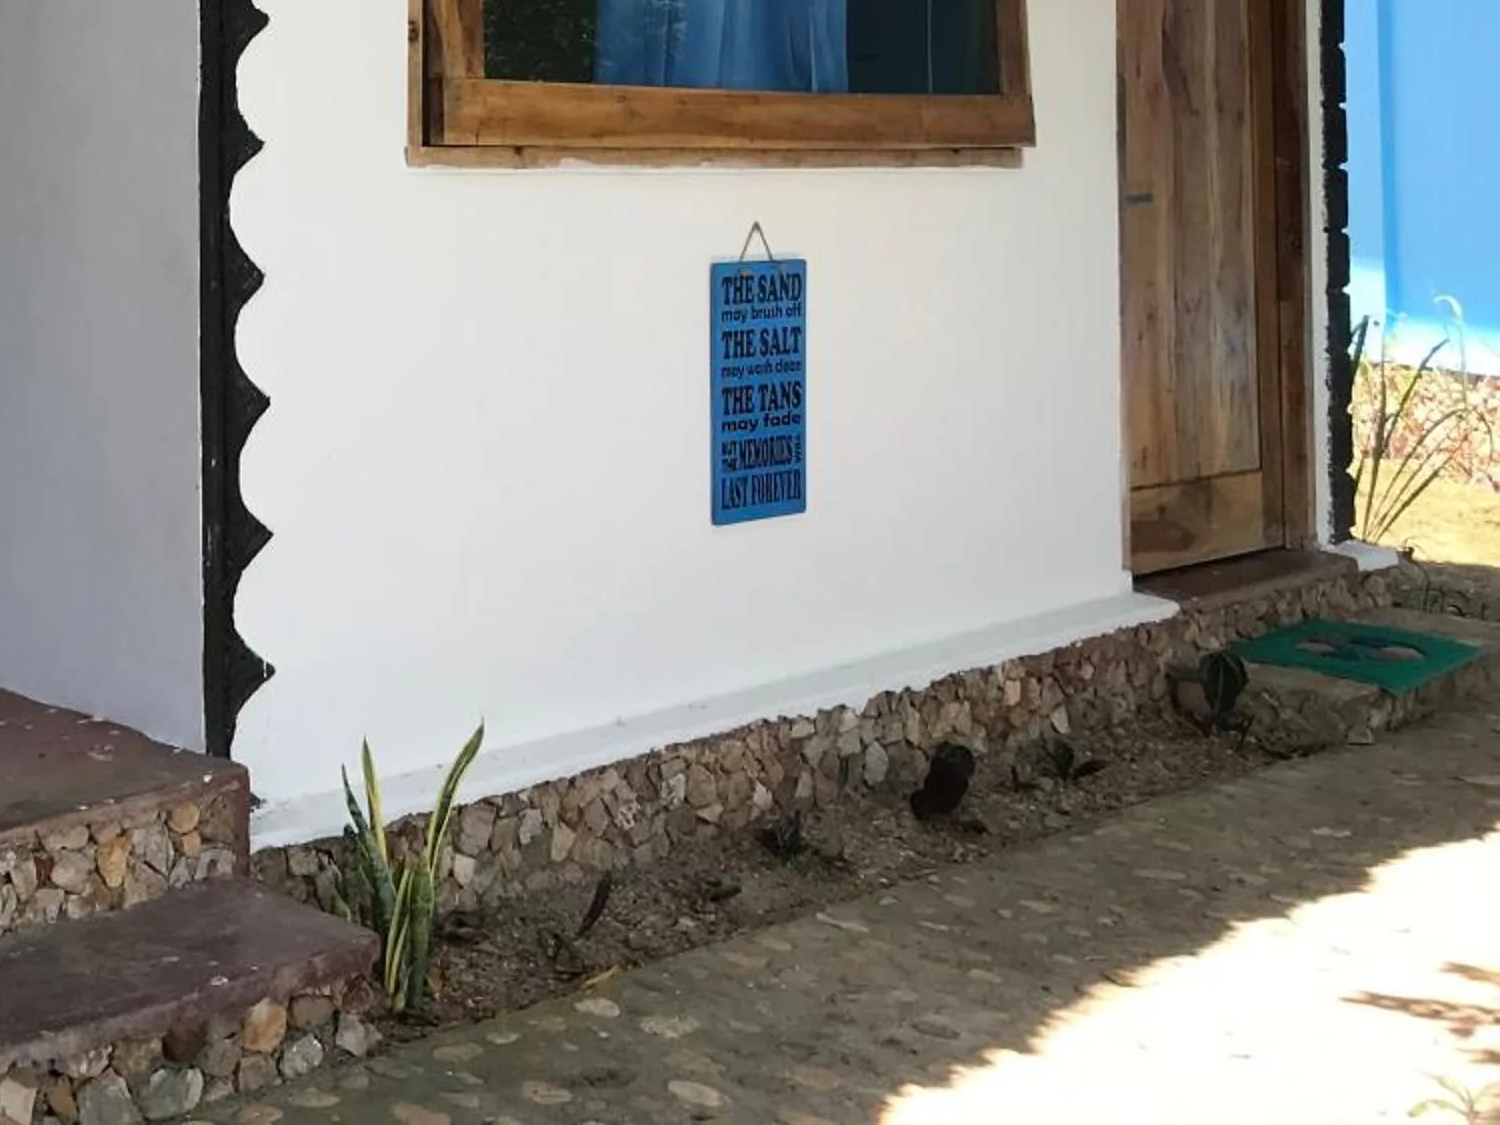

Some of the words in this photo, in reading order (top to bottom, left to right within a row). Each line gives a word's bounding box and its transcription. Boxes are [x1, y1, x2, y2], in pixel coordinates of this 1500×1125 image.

[722, 275, 755, 305] THE
[758, 273, 802, 302] SAND
[722, 329, 756, 359] THE
[759, 326, 802, 357] SALT
[722, 385, 754, 415] THE
[758, 381, 802, 412] TANS
[722, 418, 759, 433] may
[763, 412, 803, 427] fade
[739, 435, 793, 470] MEMORIES
[721, 476, 748, 510] LAST
[751, 469, 801, 505] FOREVER
